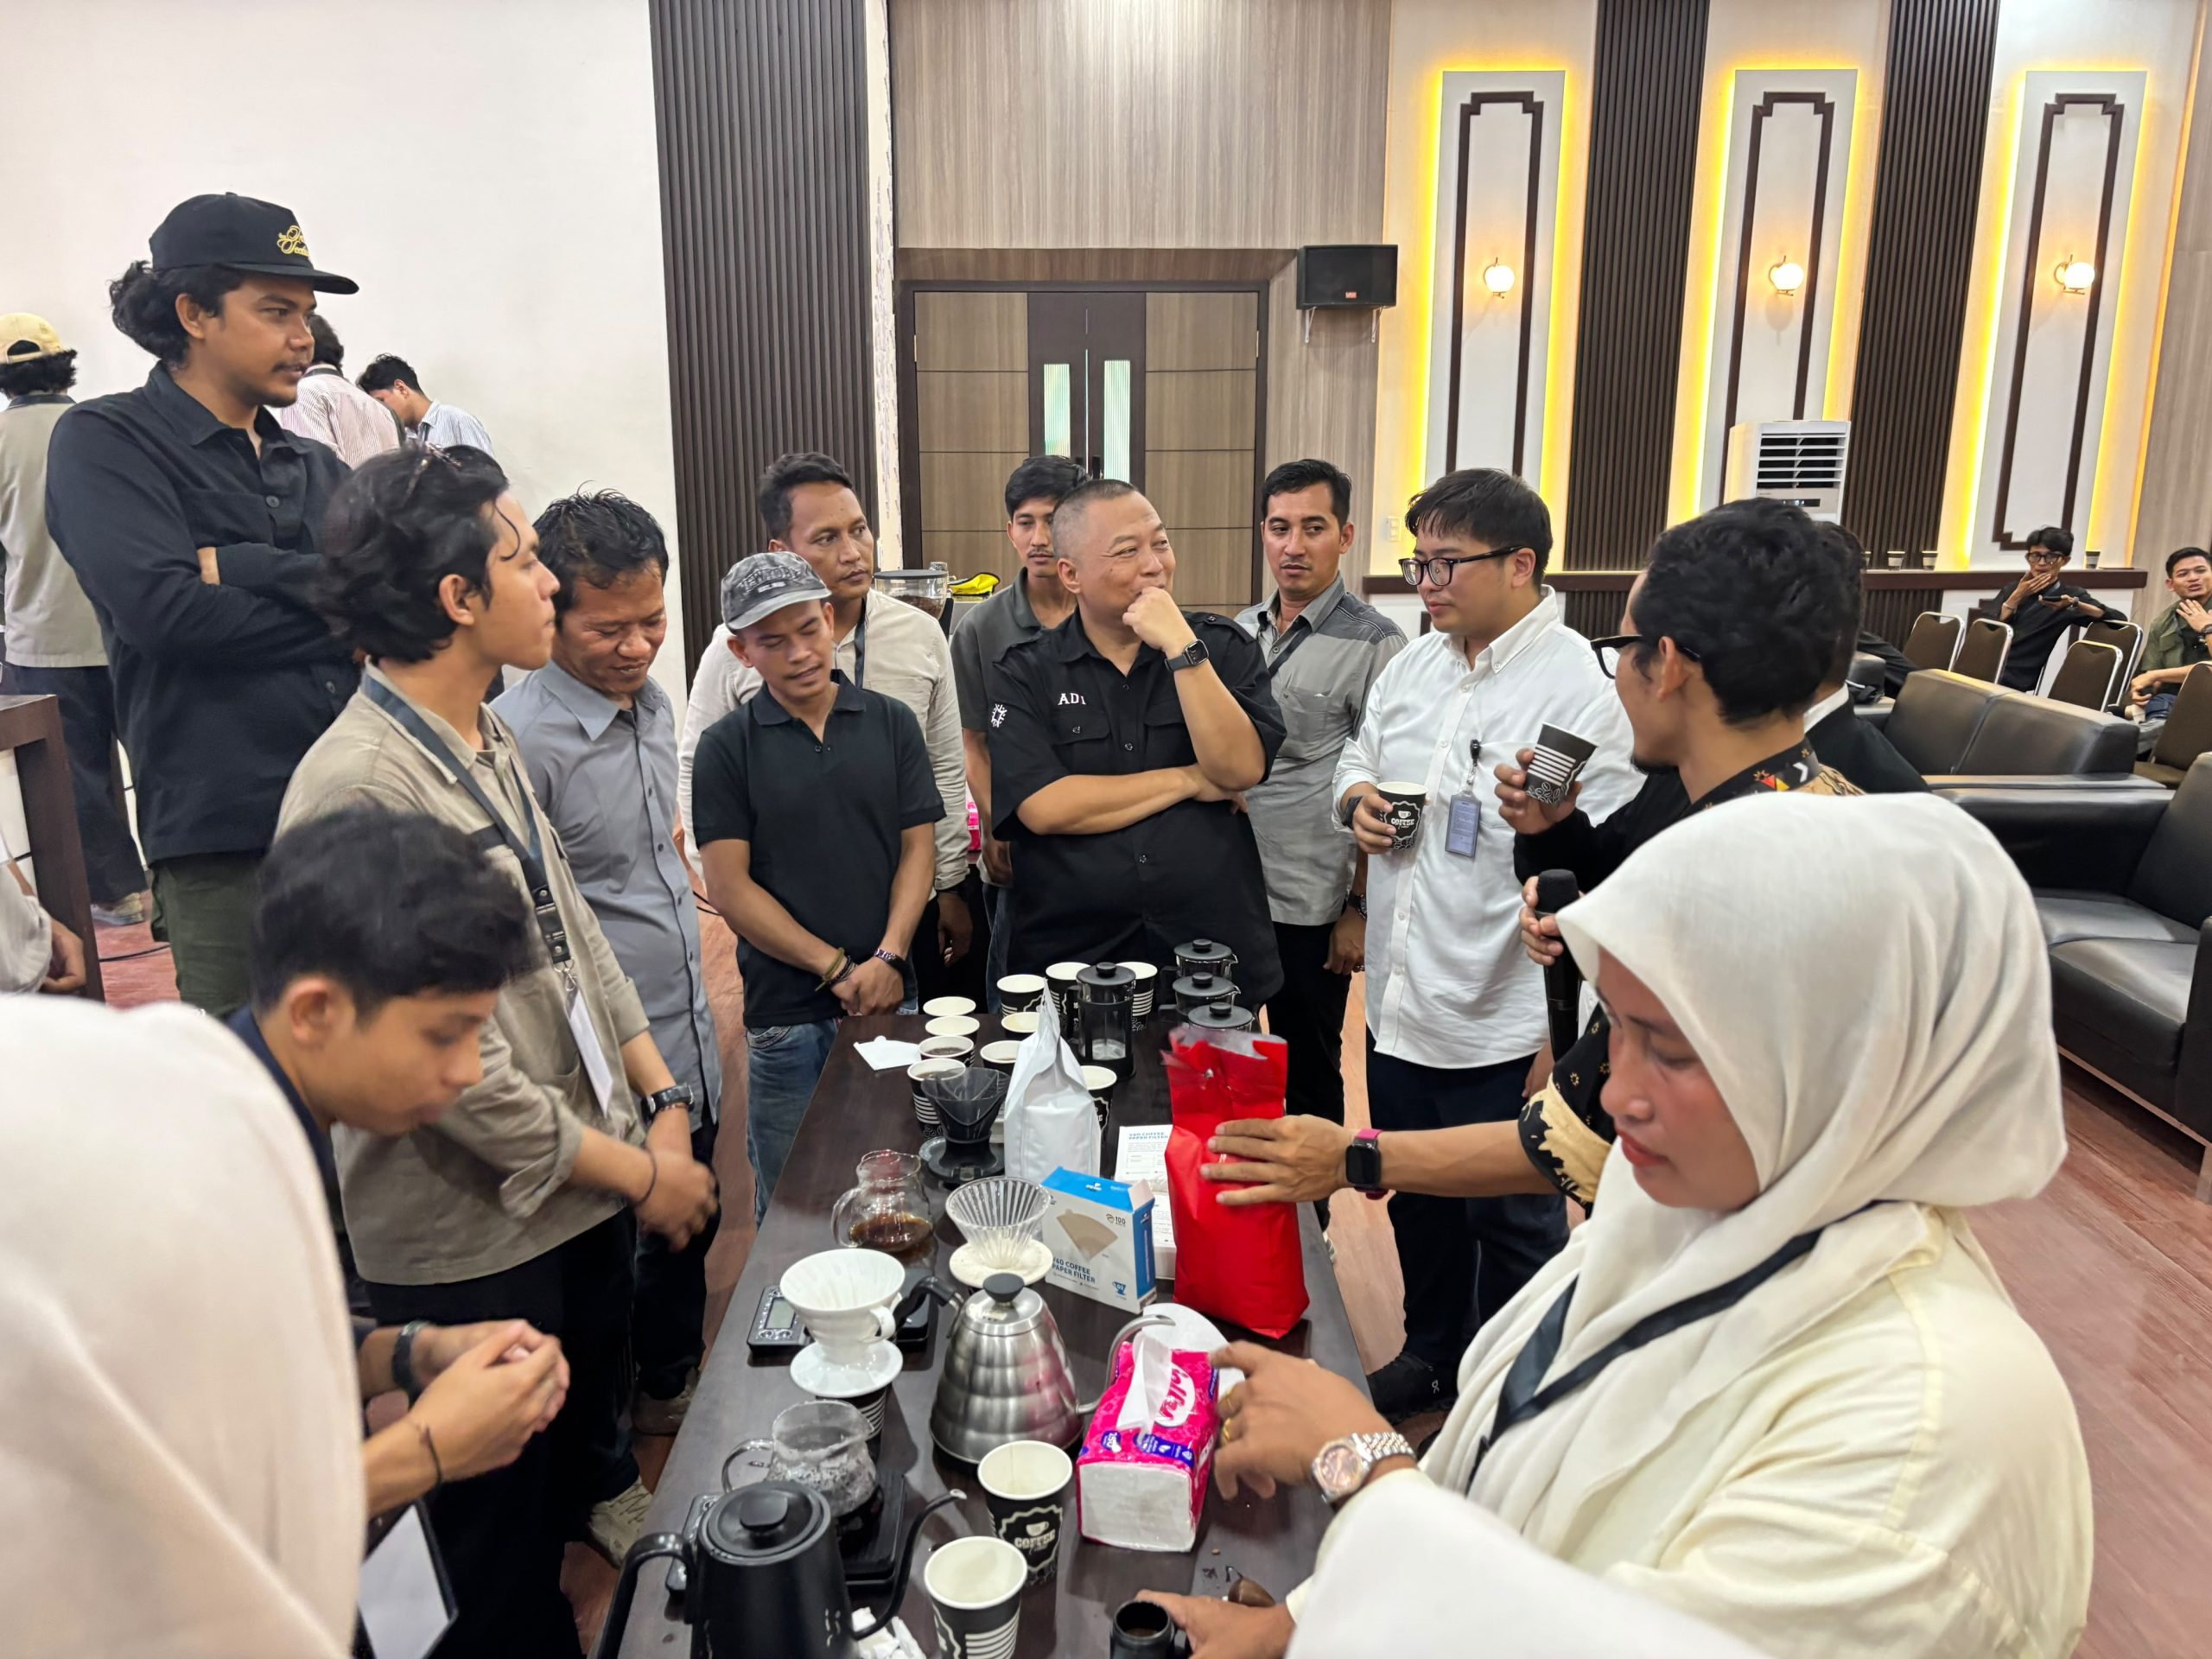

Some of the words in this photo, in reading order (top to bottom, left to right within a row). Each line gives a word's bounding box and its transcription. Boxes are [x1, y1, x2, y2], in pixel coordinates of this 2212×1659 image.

[1391, 817, 1415, 826] COFFEE
[1116, 1216, 1126, 1224] 100
[1052, 1262, 1072, 1276] PAPER
[1073, 1270, 1096, 1284] FILTER
[1065, 1261, 1091, 1275] COFFEE
[1014, 1529, 1056, 1549] COFFEE
